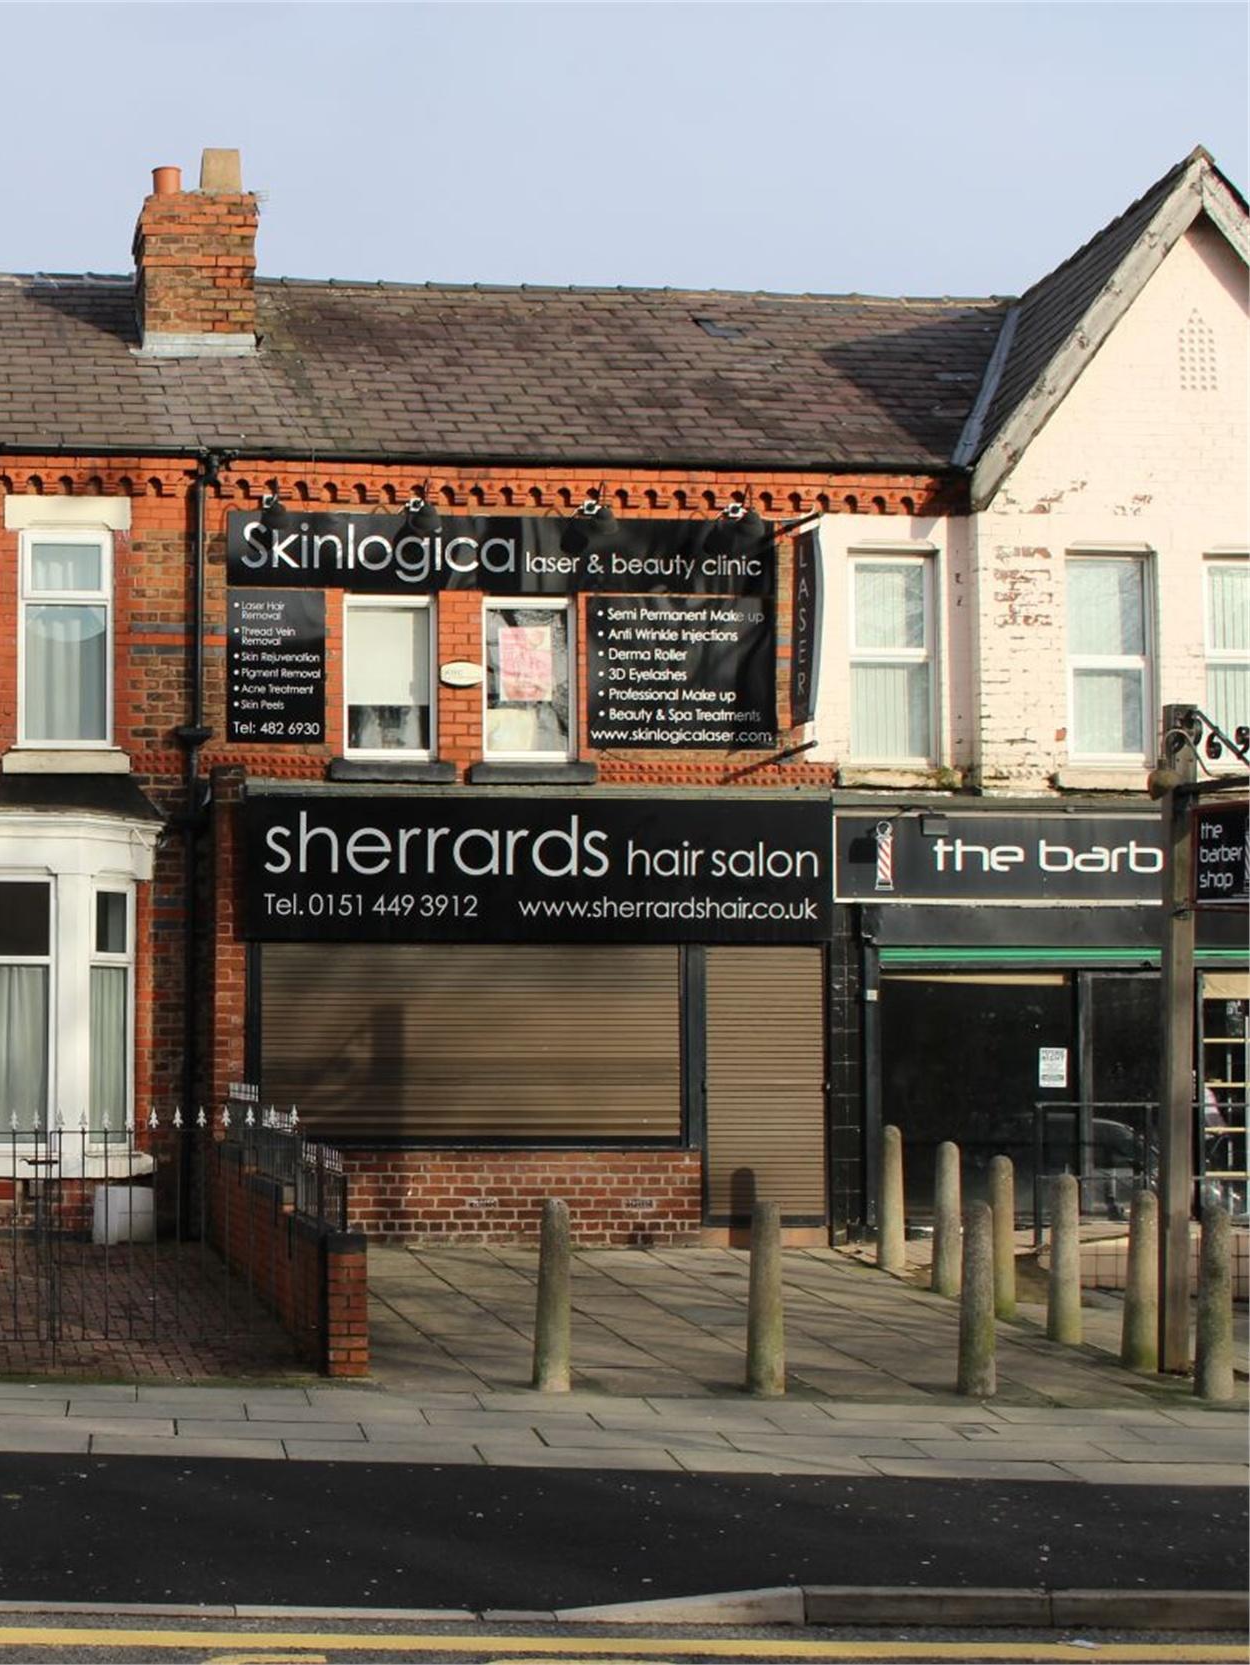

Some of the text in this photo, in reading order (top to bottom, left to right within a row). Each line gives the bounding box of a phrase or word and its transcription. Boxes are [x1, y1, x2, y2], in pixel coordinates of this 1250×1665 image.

[241, 521, 515, 583] Skinlogica
[525, 551, 762, 580] laser & beauty clinic
[241, 601, 285, 611] Laser Hair
[241, 611, 282, 621] Removal
[607, 607, 765, 626] Semi Permanent Make up
[798, 545, 809, 695] LASER
[241, 626, 296, 638] Thread Vein
[607, 627, 739, 645] Anti Wrinkle Injections
[241, 636, 282, 646] Removal
[241, 652, 321, 664] Skin Rejuvenation
[608, 648, 688, 662] Derma Roller
[241, 667, 322, 680] Pigment Removal
[608, 667, 688, 683] 3D Eyelashes
[241, 683, 314, 695] Acne Treatment
[608, 687, 737, 704] Professional Make up
[240, 699, 285, 711] Skin Peels
[609, 707, 762, 724] Beauty & Spa Treatments
[233, 720, 321, 736] Tel: 482 6930
[590, 727, 774, 745] www.skinlogicalaser.com
[1200, 823, 1223, 840] the
[264, 810, 819, 878] sherrards hair salon
[932, 838, 1164, 873] the barb
[1199, 846, 1243, 864] barber
[1199, 871, 1234, 890] shop
[263, 892, 478, 917] Tel. 0151 449 3912
[518, 895, 818, 920] www.sherrardshair.co.uk
